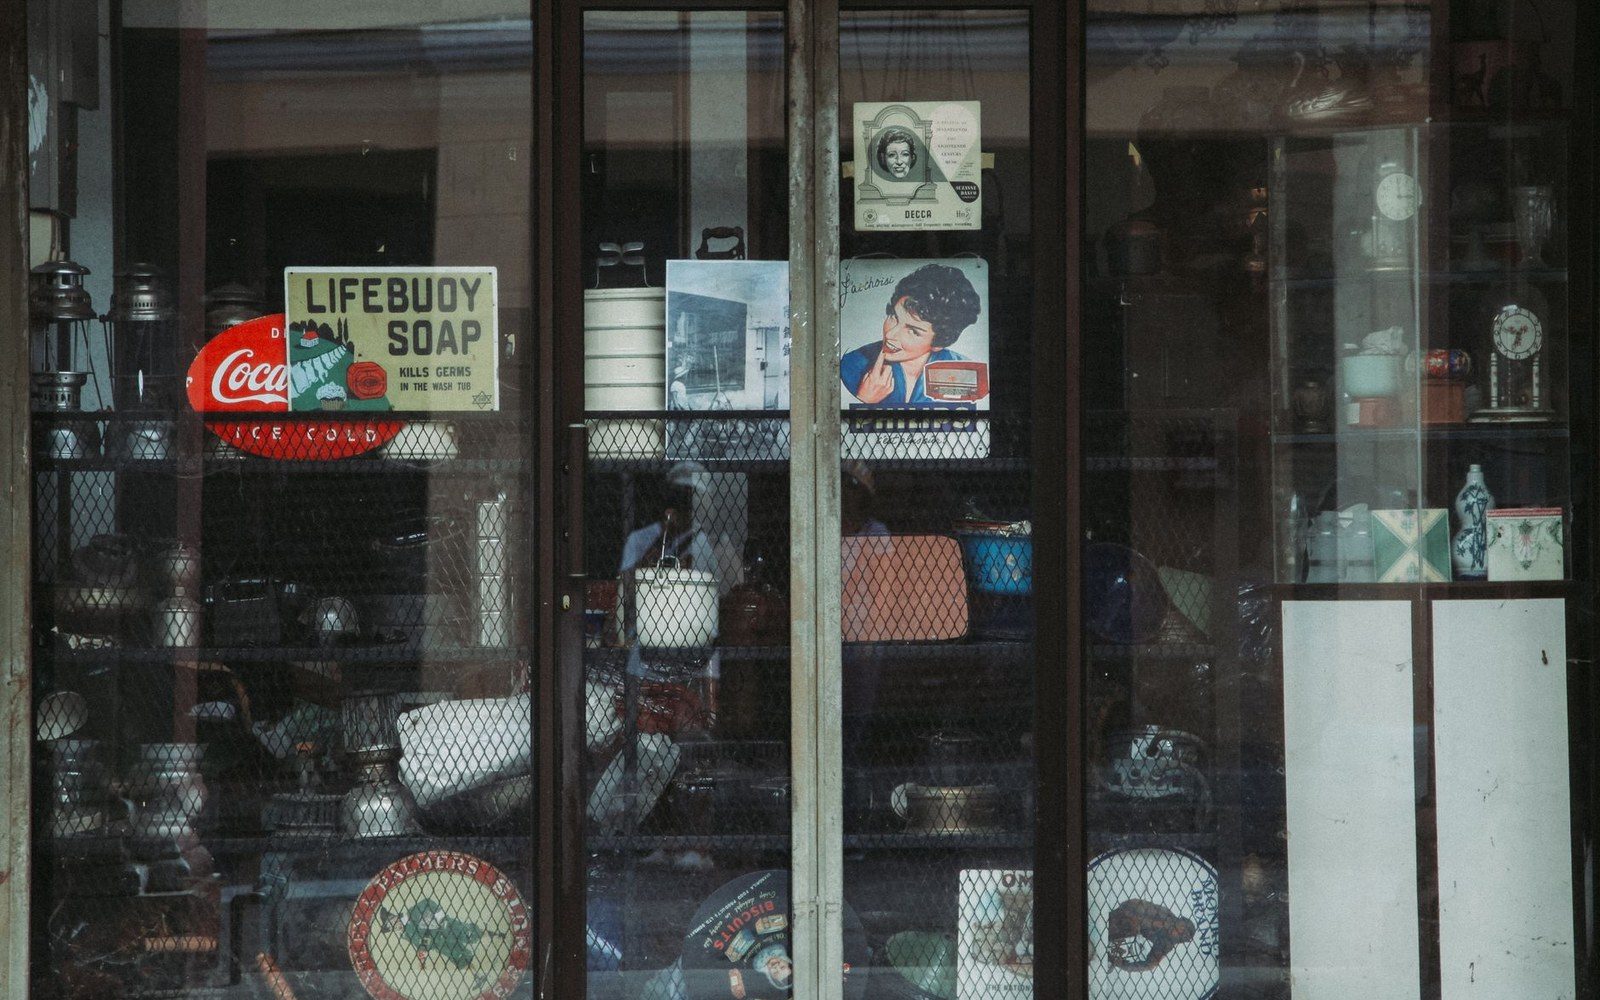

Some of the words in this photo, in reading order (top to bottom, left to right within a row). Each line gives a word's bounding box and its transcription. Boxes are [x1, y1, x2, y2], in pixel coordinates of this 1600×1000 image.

[904, 210, 932, 219] DECCA
[306, 277, 482, 313] LIFEBUOY
[388, 319, 482, 356] SOAP
[211, 348, 288, 404] Coca
[399, 366, 430, 378] KILLS
[435, 366, 472, 378] GERMS
[400, 382, 409, 391] IN
[413, 382, 428, 391] THE
[432, 382, 453, 391] WASH
[457, 382, 472, 391] TUB
[235, 426, 282, 440] ICE
[307, 427, 377, 443] COLD
[376, 854, 480, 893] PALMERS
[713, 900, 775, 951] BISCUITS
[1192, 888, 1213, 956] BRAND
